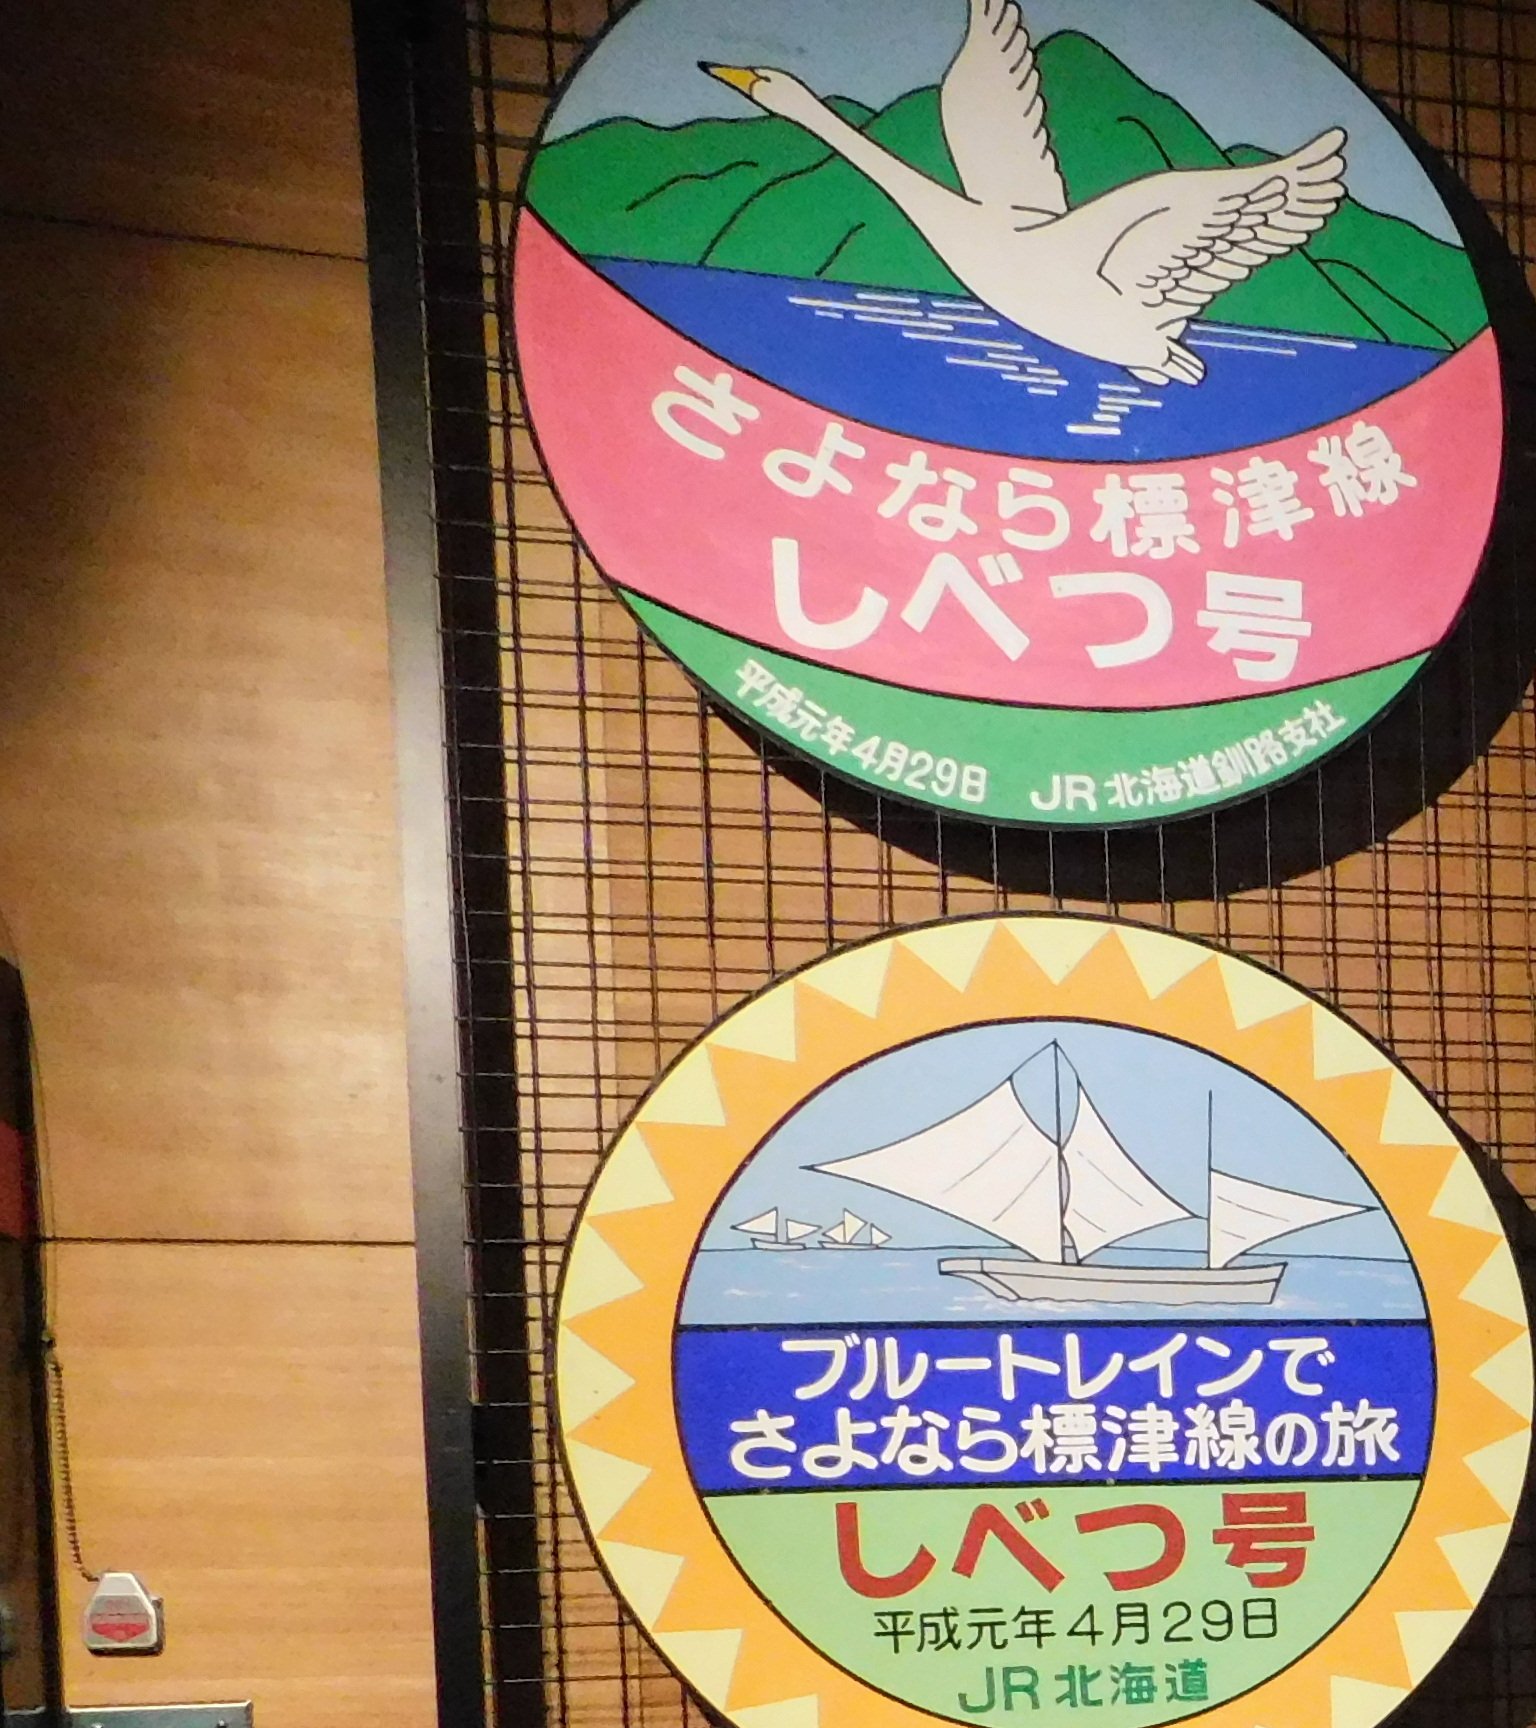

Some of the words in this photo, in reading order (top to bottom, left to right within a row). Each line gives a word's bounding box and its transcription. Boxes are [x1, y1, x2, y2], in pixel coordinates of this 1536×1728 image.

[652, 364, 1418, 560] さよなら標津線
[771, 536, 1311, 681] しべつ号
[734, 659, 987, 804] 平成元年4月29日
[781, 1332, 1336, 1401] ブルートレインで
[729, 1399, 1400, 1479] さよなら標津線の旅
[836, 1491, 1314, 1599] しべつ号
[873, 1599, 1277, 1654] 平成元年4月29日
